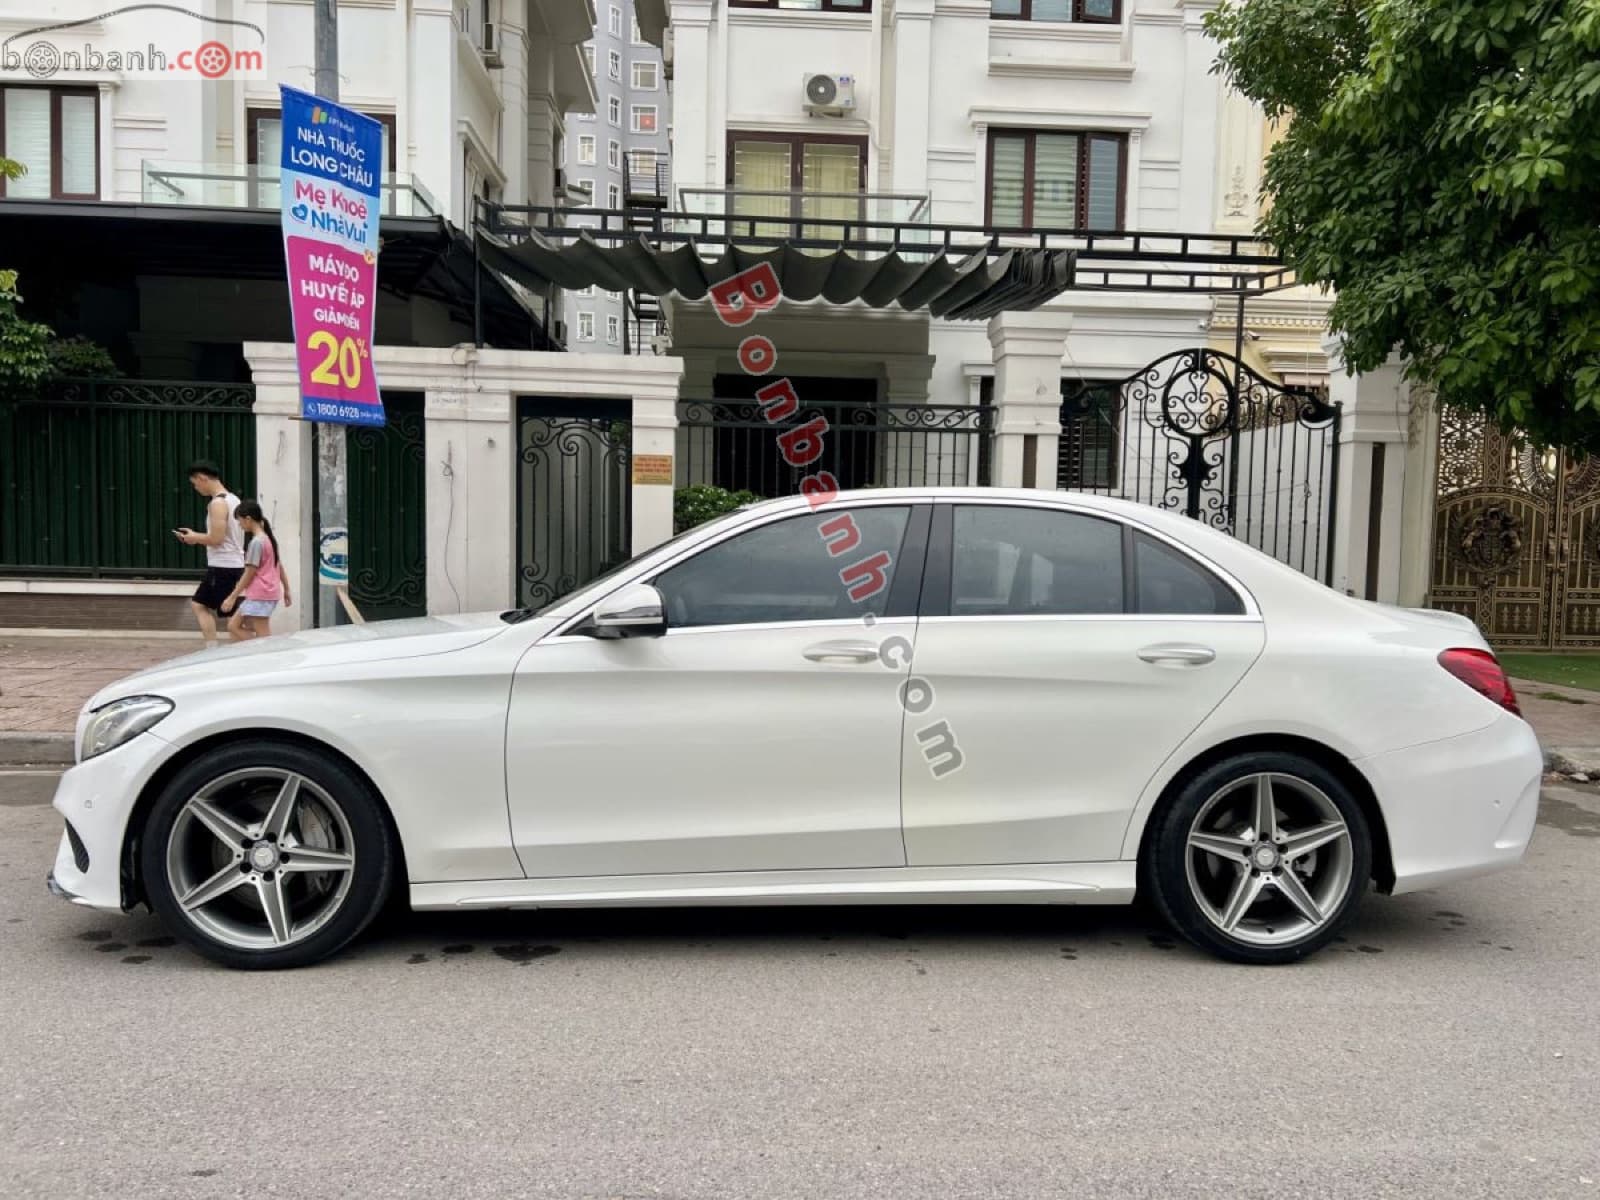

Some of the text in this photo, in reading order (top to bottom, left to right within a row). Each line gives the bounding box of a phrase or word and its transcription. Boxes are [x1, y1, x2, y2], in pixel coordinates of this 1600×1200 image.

[298, 126, 365, 162] NHÀ THUỐC
[291, 145, 373, 188] LONG CHÂU
[294, 179, 326, 209] Mẹ
[311, 209, 368, 244] Nhà Vui
[309, 253, 344, 277] MÁY
[301, 279, 365, 309] HUYẾ ÁP
[317, 403, 337, 417] 1800
